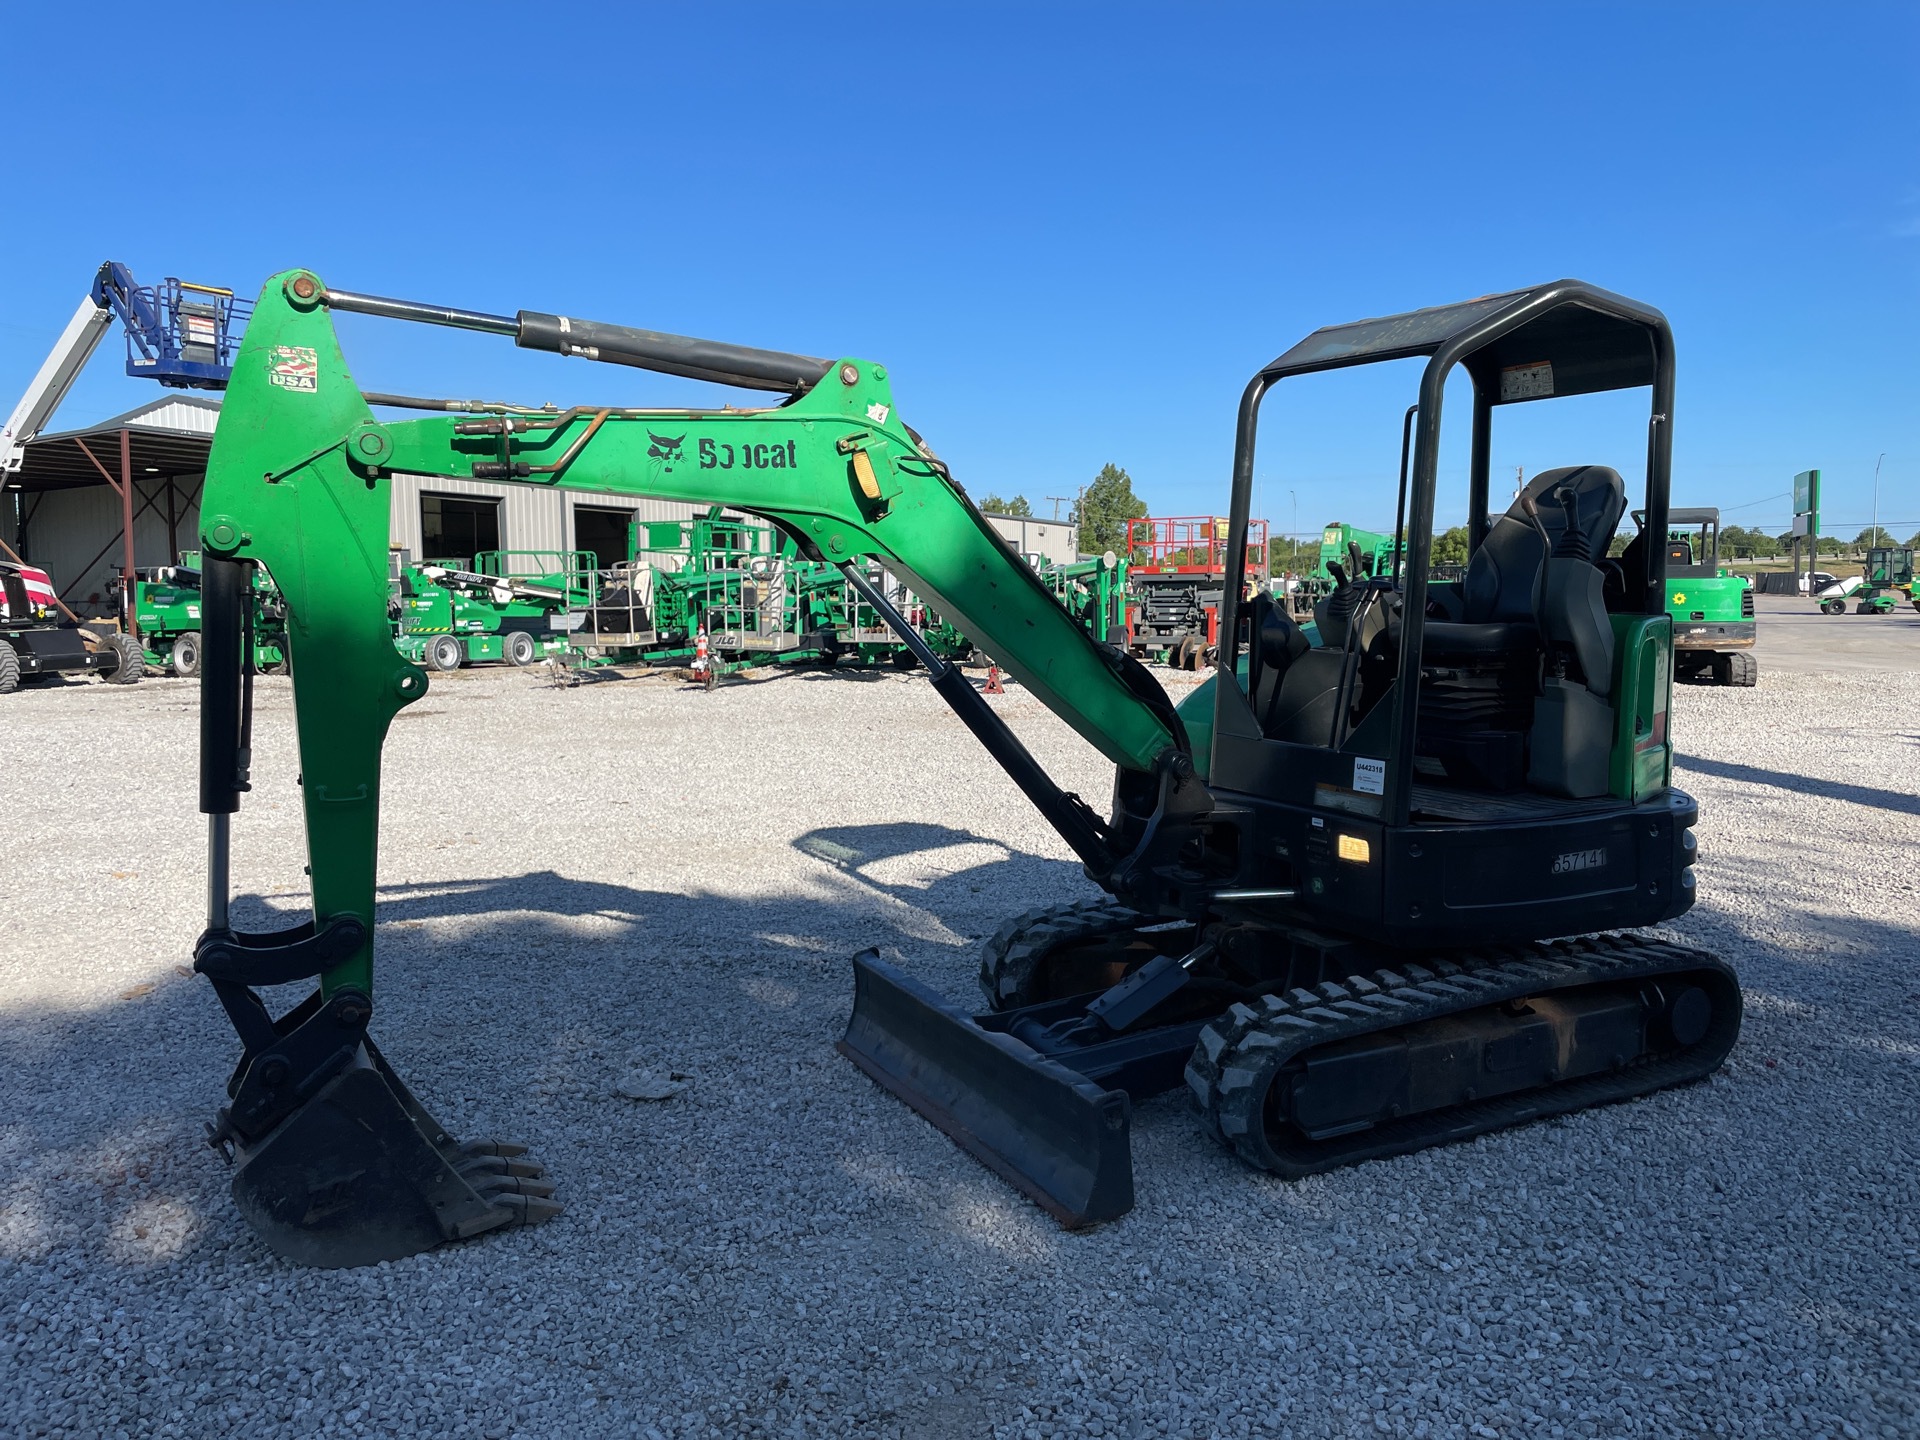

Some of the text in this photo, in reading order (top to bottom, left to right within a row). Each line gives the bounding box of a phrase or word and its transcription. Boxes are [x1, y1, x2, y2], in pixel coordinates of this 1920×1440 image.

[272, 374, 313, 388] USA
[715, 636, 736, 645] JLG
[1356, 762, 1384, 774] U442318
